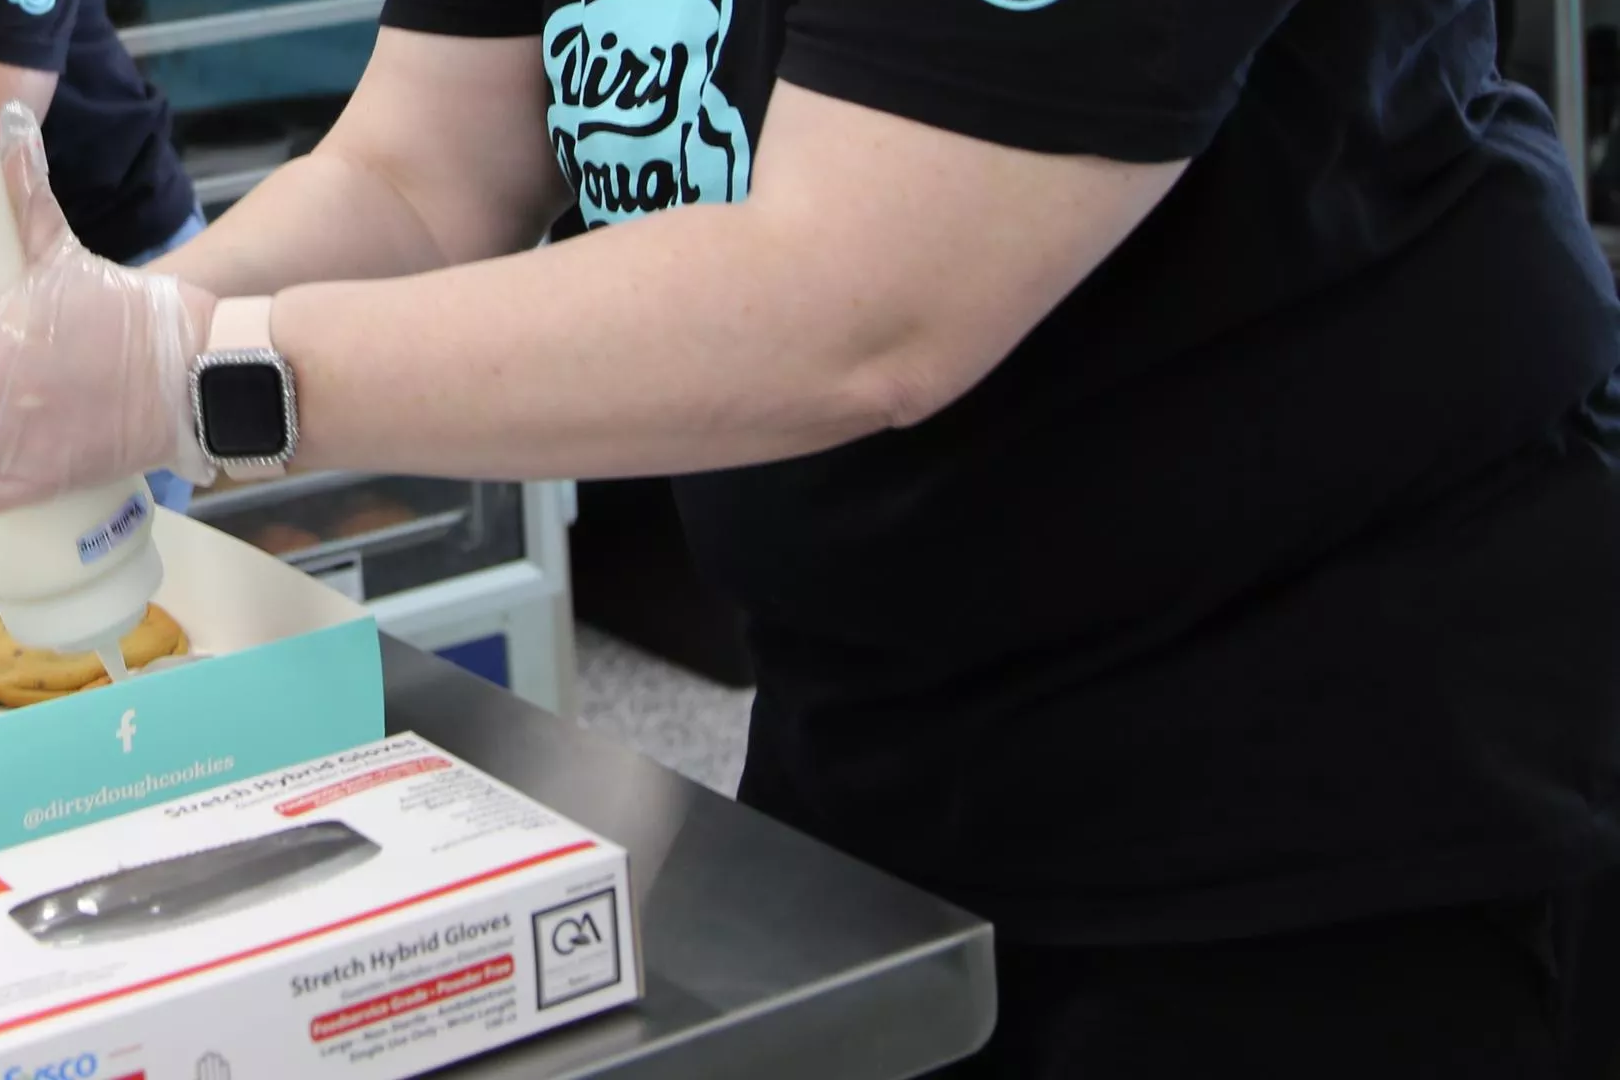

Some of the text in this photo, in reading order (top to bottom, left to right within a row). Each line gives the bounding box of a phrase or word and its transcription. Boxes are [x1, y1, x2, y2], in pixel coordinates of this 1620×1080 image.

[115, 708, 137, 753] f
[23, 754, 235, 830] @dirtydoughcookies
[290, 958, 365, 998] Stretch
[369, 932, 440, 971] Hybrid
[444, 913, 512, 947] Gloves
[4, 1053, 98, 1080] sco
